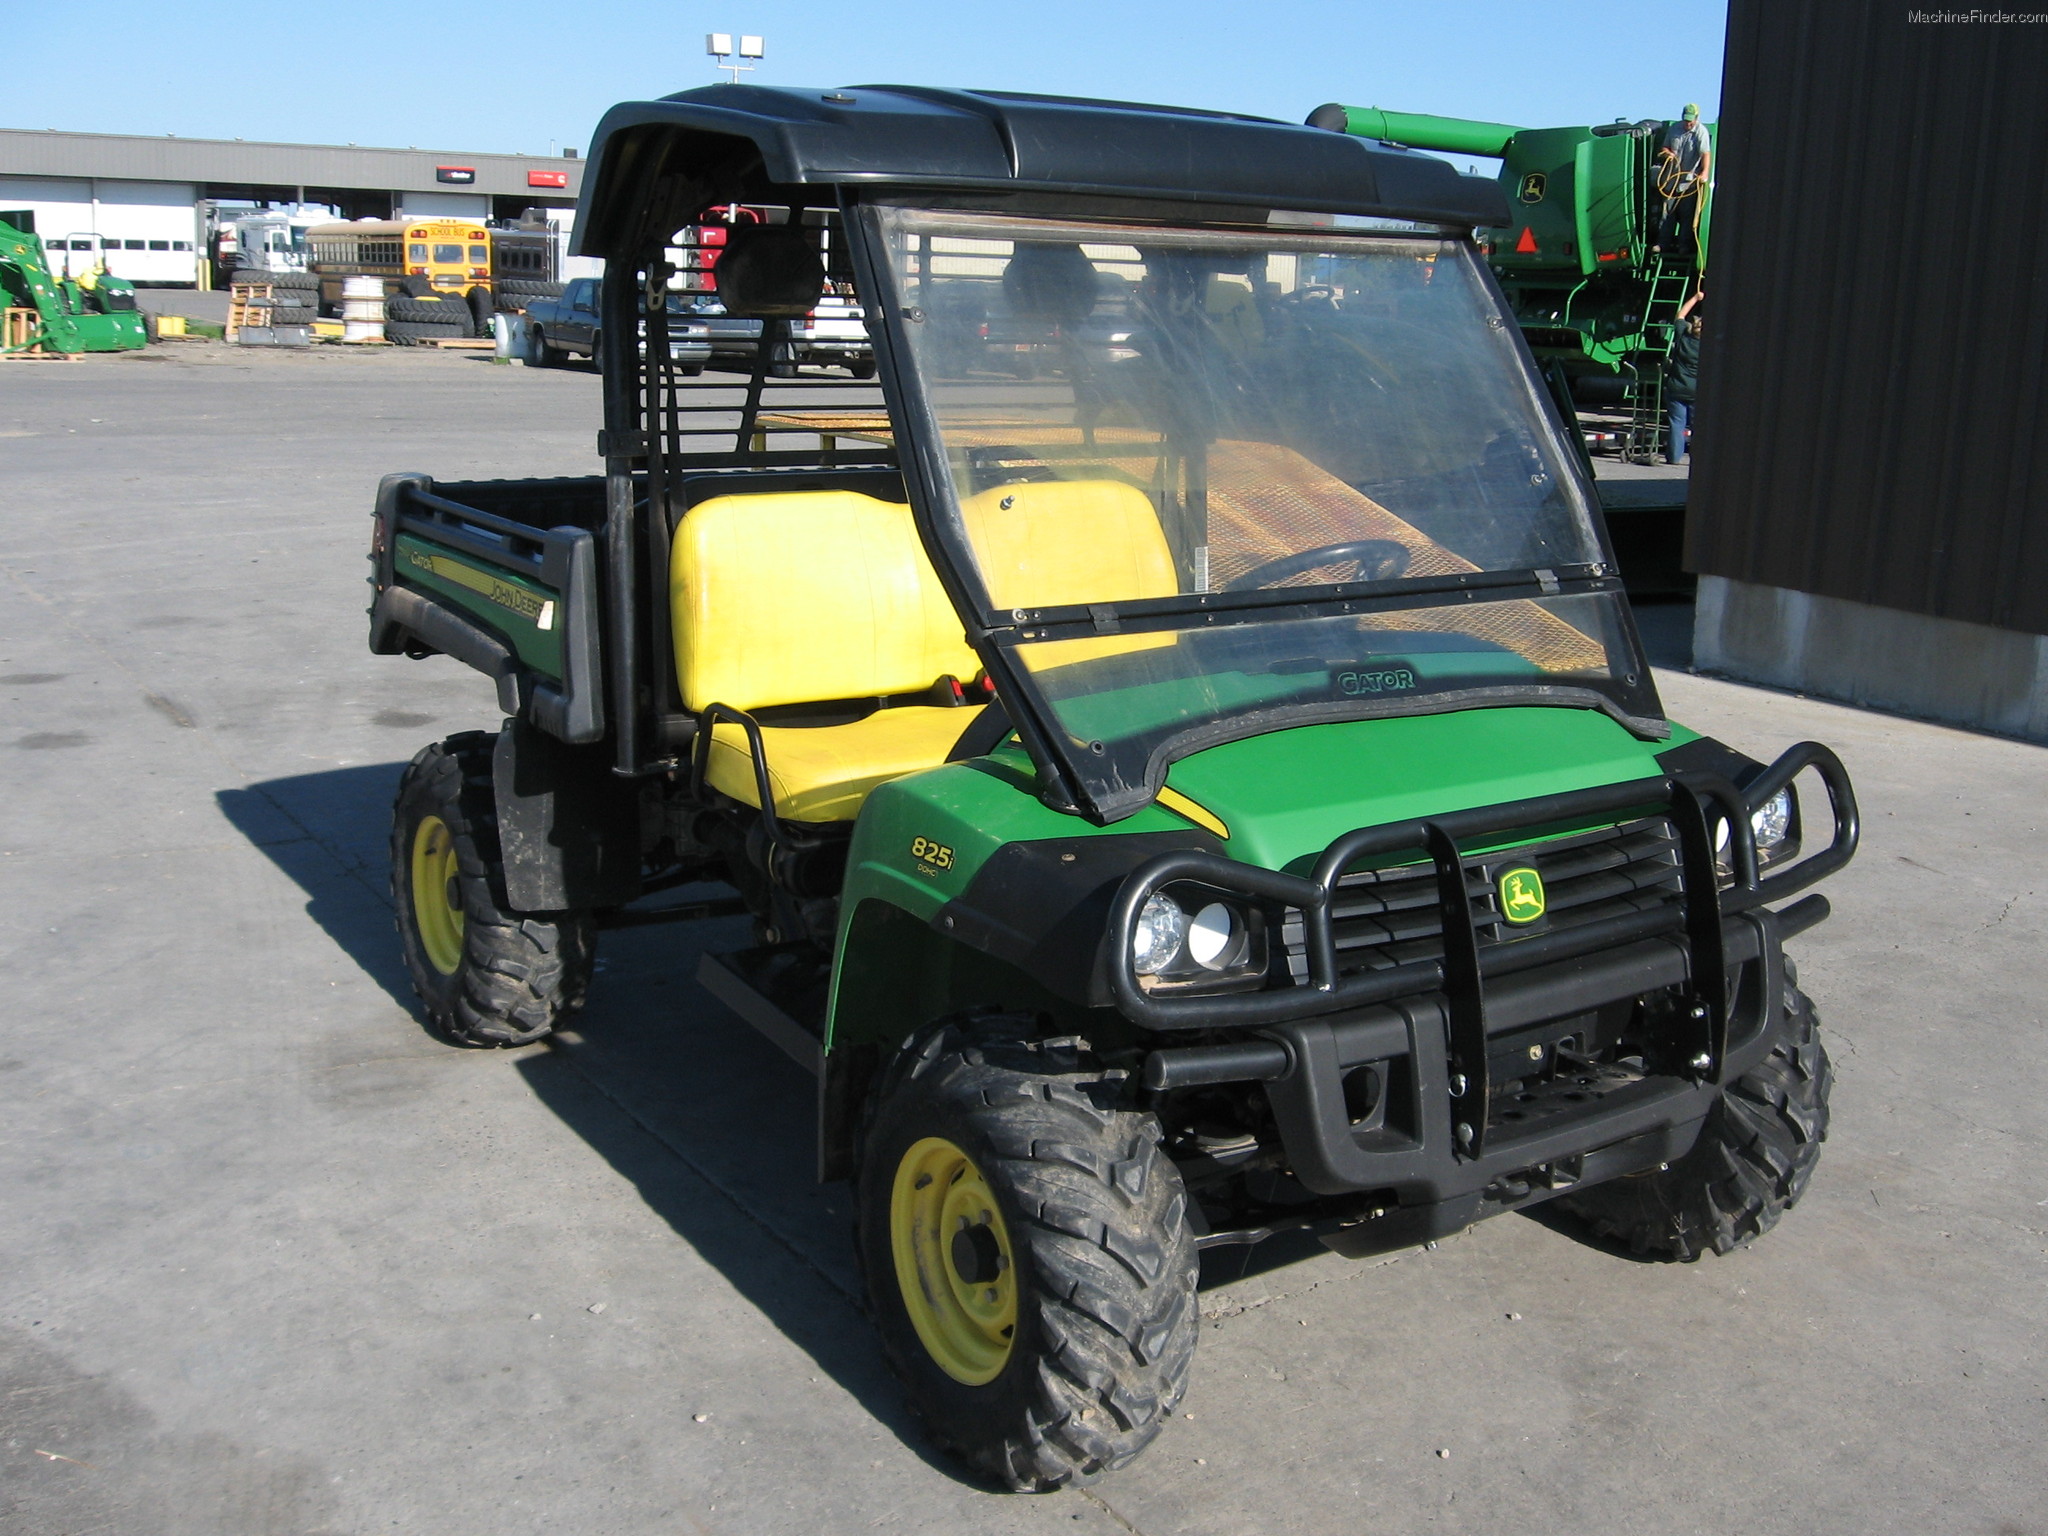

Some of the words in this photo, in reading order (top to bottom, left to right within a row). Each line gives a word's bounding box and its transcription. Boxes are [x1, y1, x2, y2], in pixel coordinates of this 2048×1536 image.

[430, 227, 452, 236] SCHOOL
[453, 228, 465, 237] BUS
[490, 579, 515, 608] JOHN
[1338, 669, 1416, 695] GATOR
[911, 836, 955, 870] 825i
